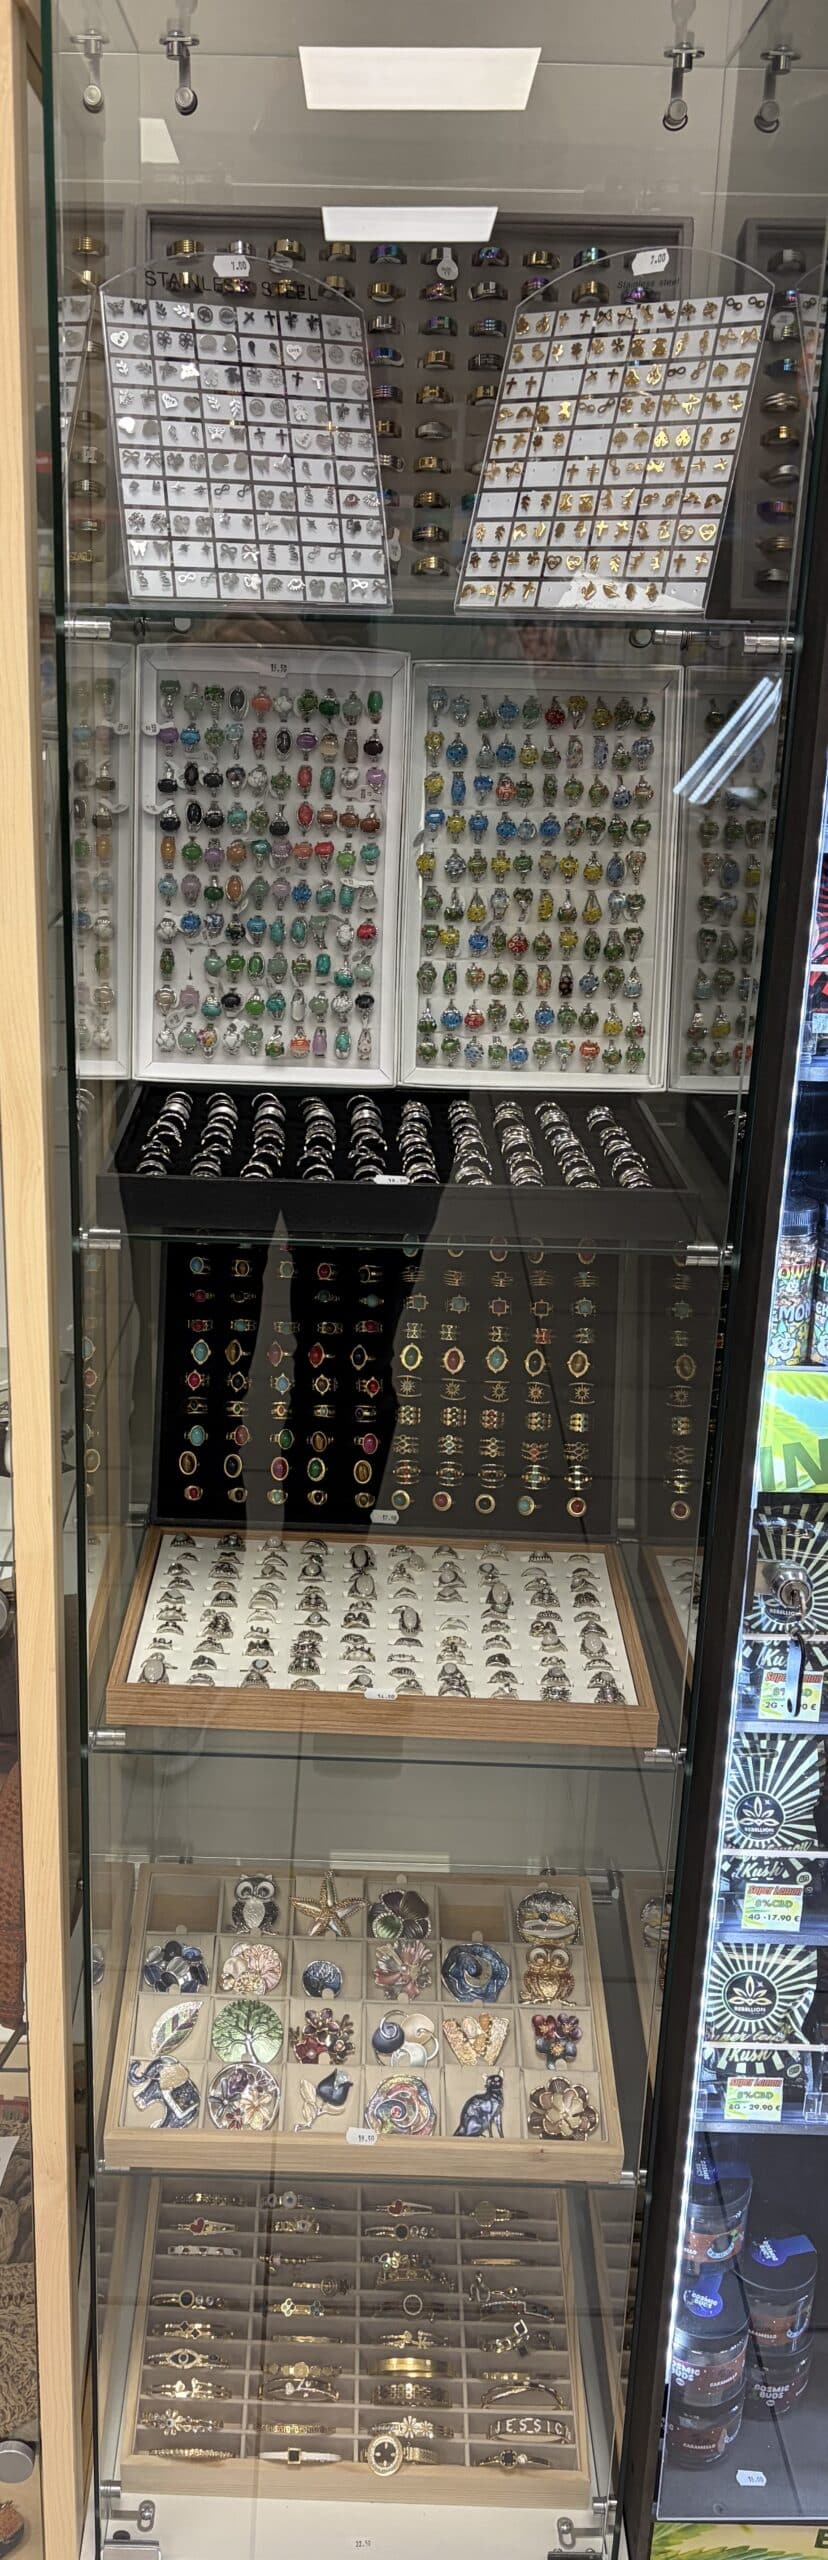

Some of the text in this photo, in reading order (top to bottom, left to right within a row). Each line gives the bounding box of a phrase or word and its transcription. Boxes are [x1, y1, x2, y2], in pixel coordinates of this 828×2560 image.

[144, 270, 253, 295] STAINLES
[741, 1861, 784, 1878] Kush
[754, 2384, 789, 2393] COSMIC
[760, 2391, 784, 2400] BUDS
